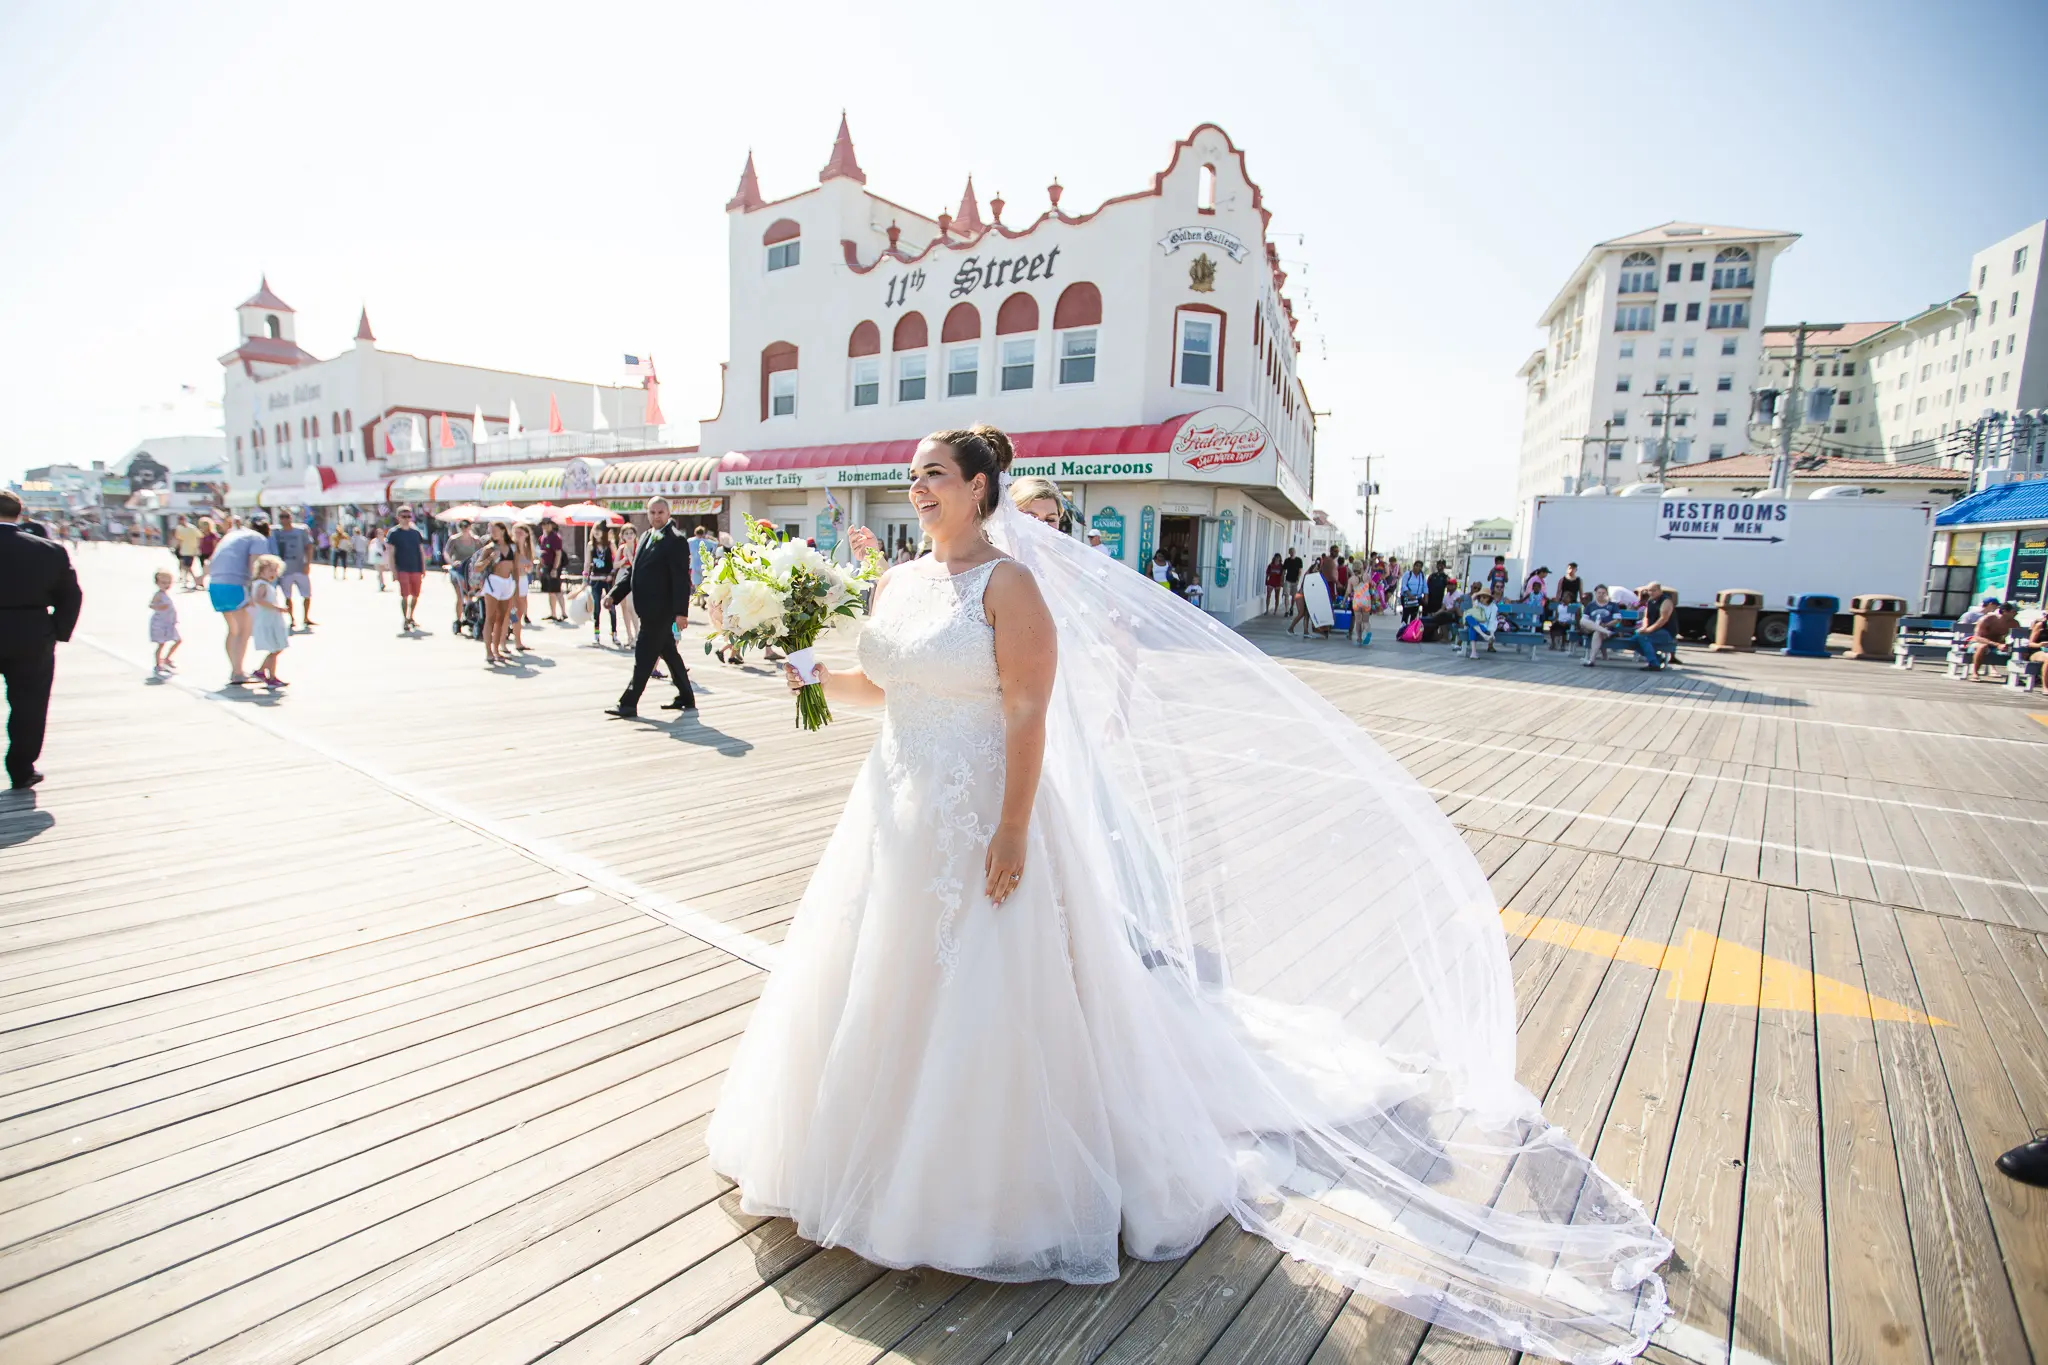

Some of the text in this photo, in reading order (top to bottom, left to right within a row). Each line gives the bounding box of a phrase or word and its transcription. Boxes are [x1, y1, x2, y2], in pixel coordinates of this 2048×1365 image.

[1170, 229, 1202, 244] Golden
[885, 244, 1061, 308] 11th Street
[838, 467, 903, 482] Homemade
[1009, 461, 1153, 477] mond Macaroons
[725, 475, 743, 486] Salt
[744, 474, 773, 486] Water
[776, 473, 803, 486] Taffy
[1662, 502, 1787, 522] RESTROOMS
[1093, 520, 1122, 528] CANDIES
[1669, 521, 1763, 533] WOMEN MEN
